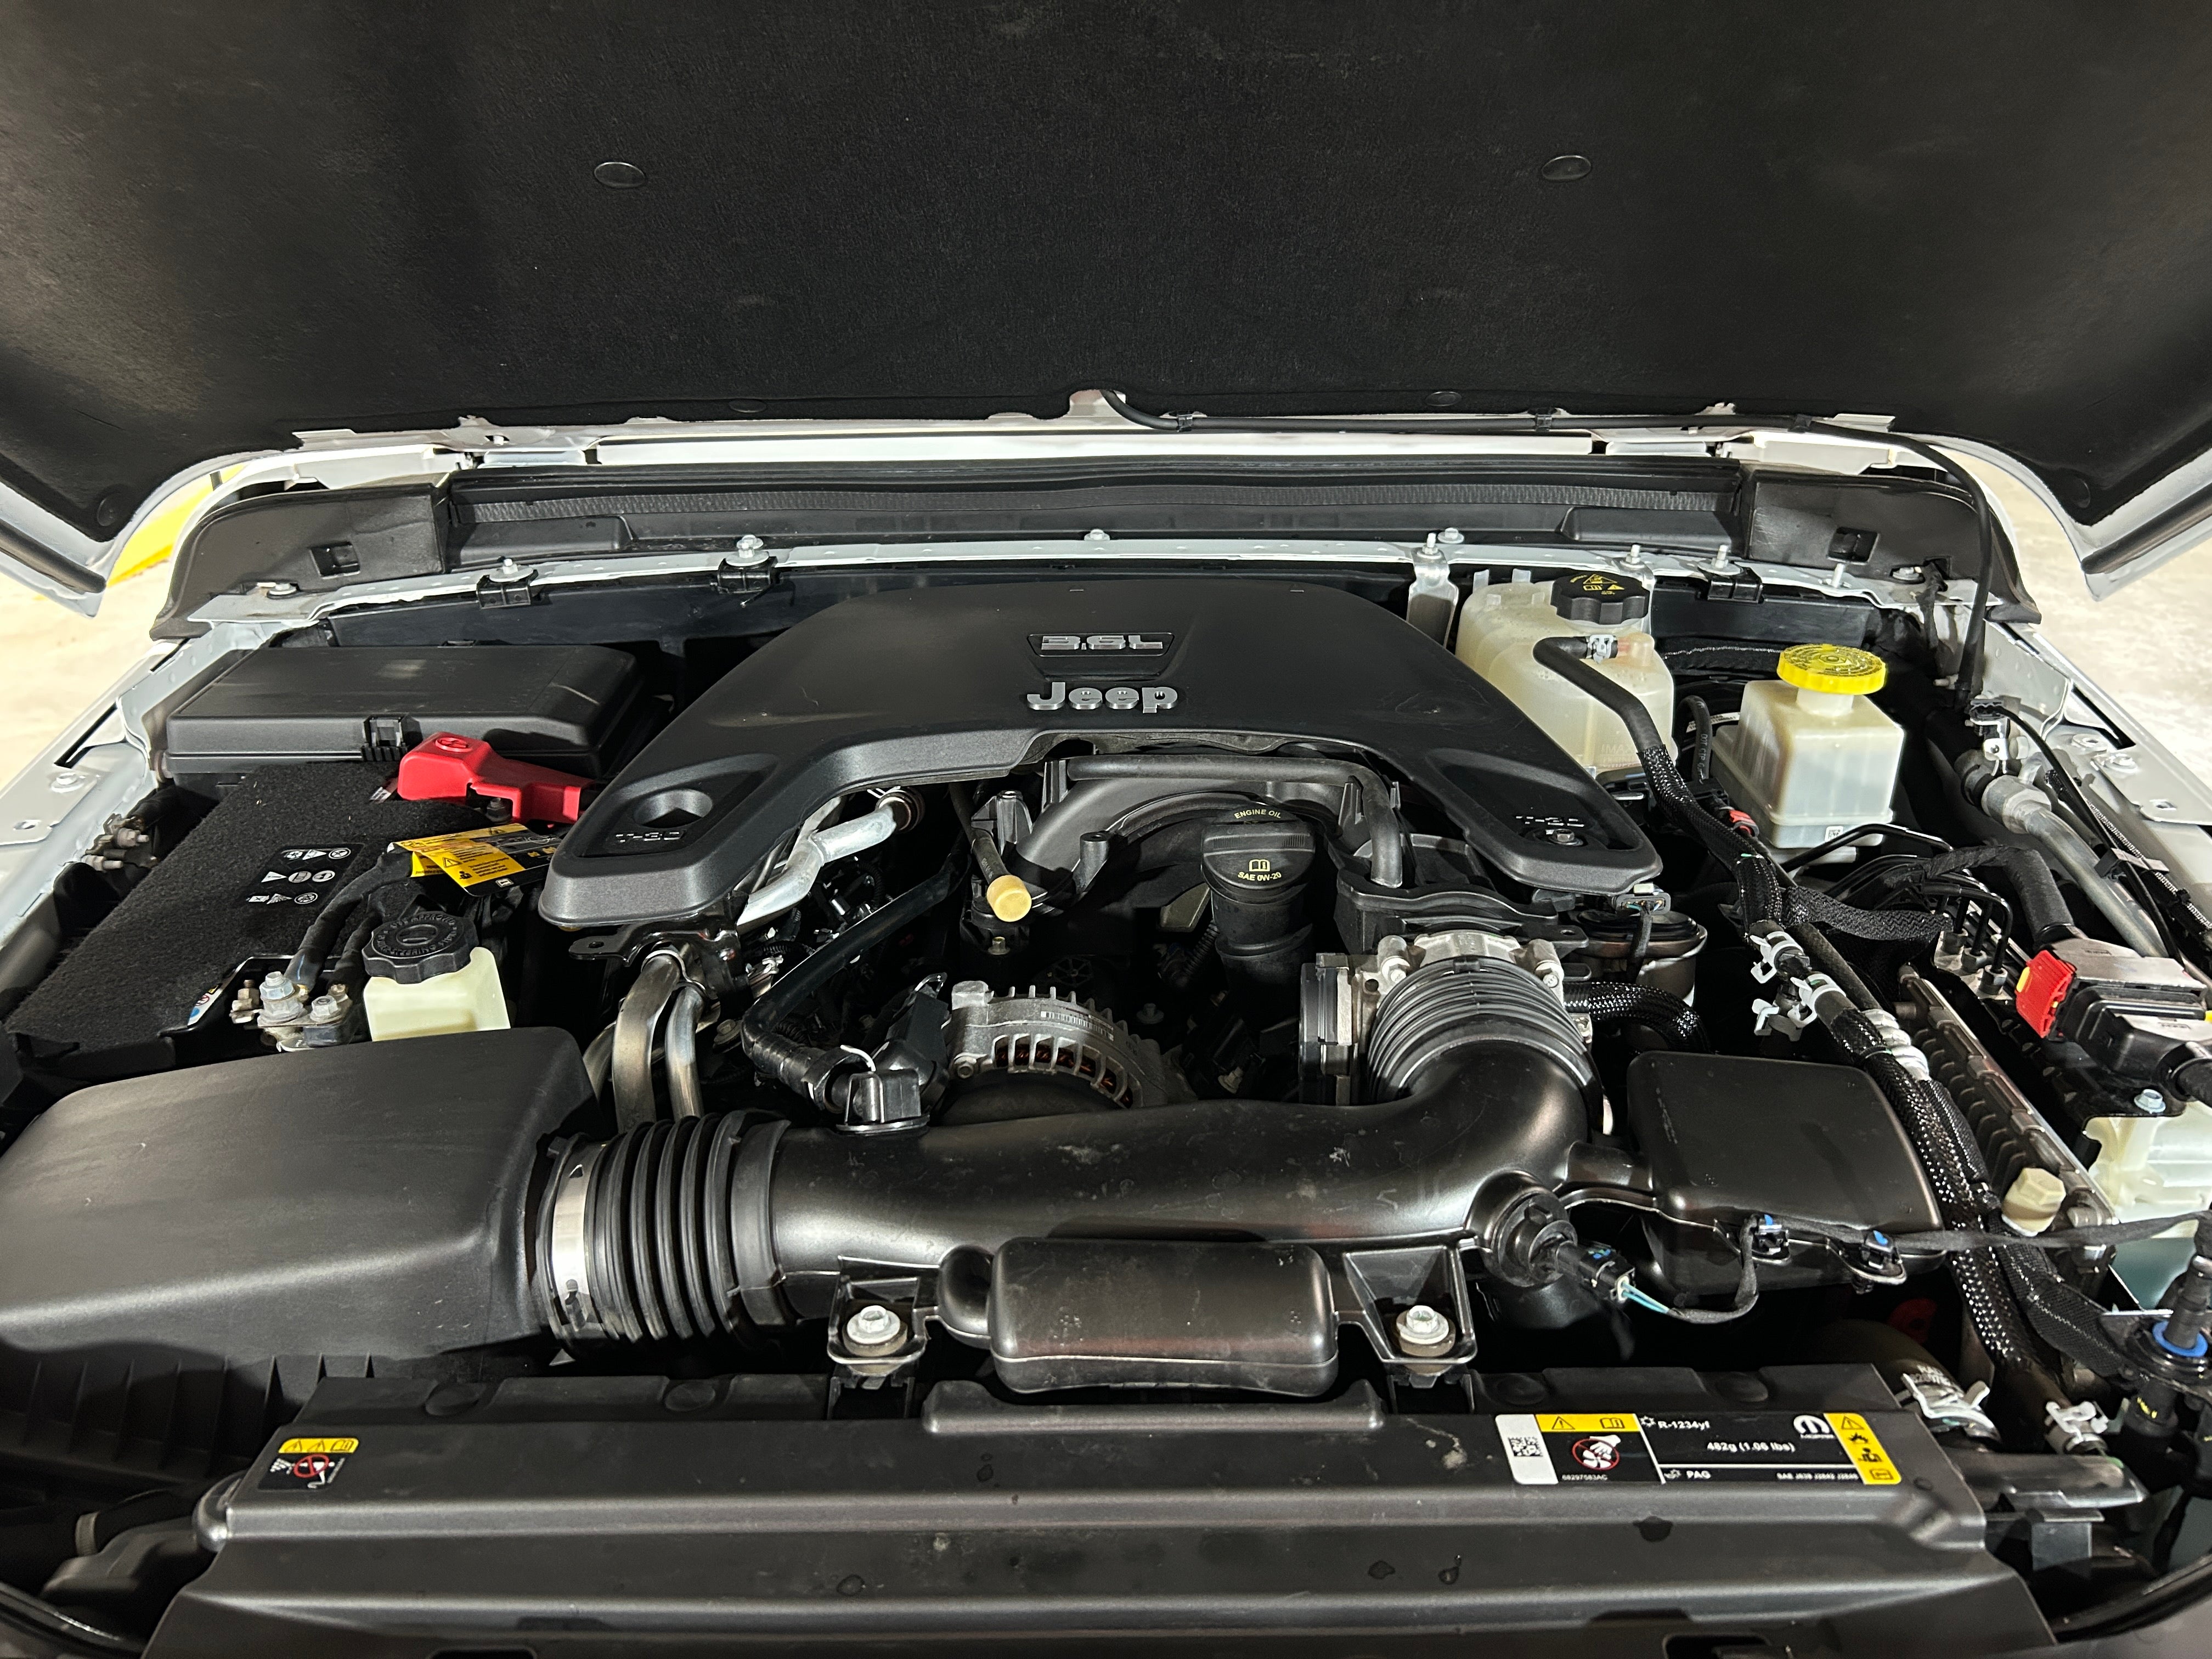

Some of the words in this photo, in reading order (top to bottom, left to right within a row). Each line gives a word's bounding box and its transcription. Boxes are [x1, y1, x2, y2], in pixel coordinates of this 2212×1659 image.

[1041, 635, 1163, 650] 3.6L
[1026, 682, 1178, 713] Jeep
[1234, 809, 1267, 819] ENGINE
[1268, 810, 1281, 819] OIL
[1237, 871, 1256, 881] SAE
[1257, 871, 1282, 881] 0W-20
[1658, 1420, 1710, 1431] R-1234yf
[1770, 1442, 1796, 1453] lbs)
[1686, 1470, 1712, 1480] PAG
